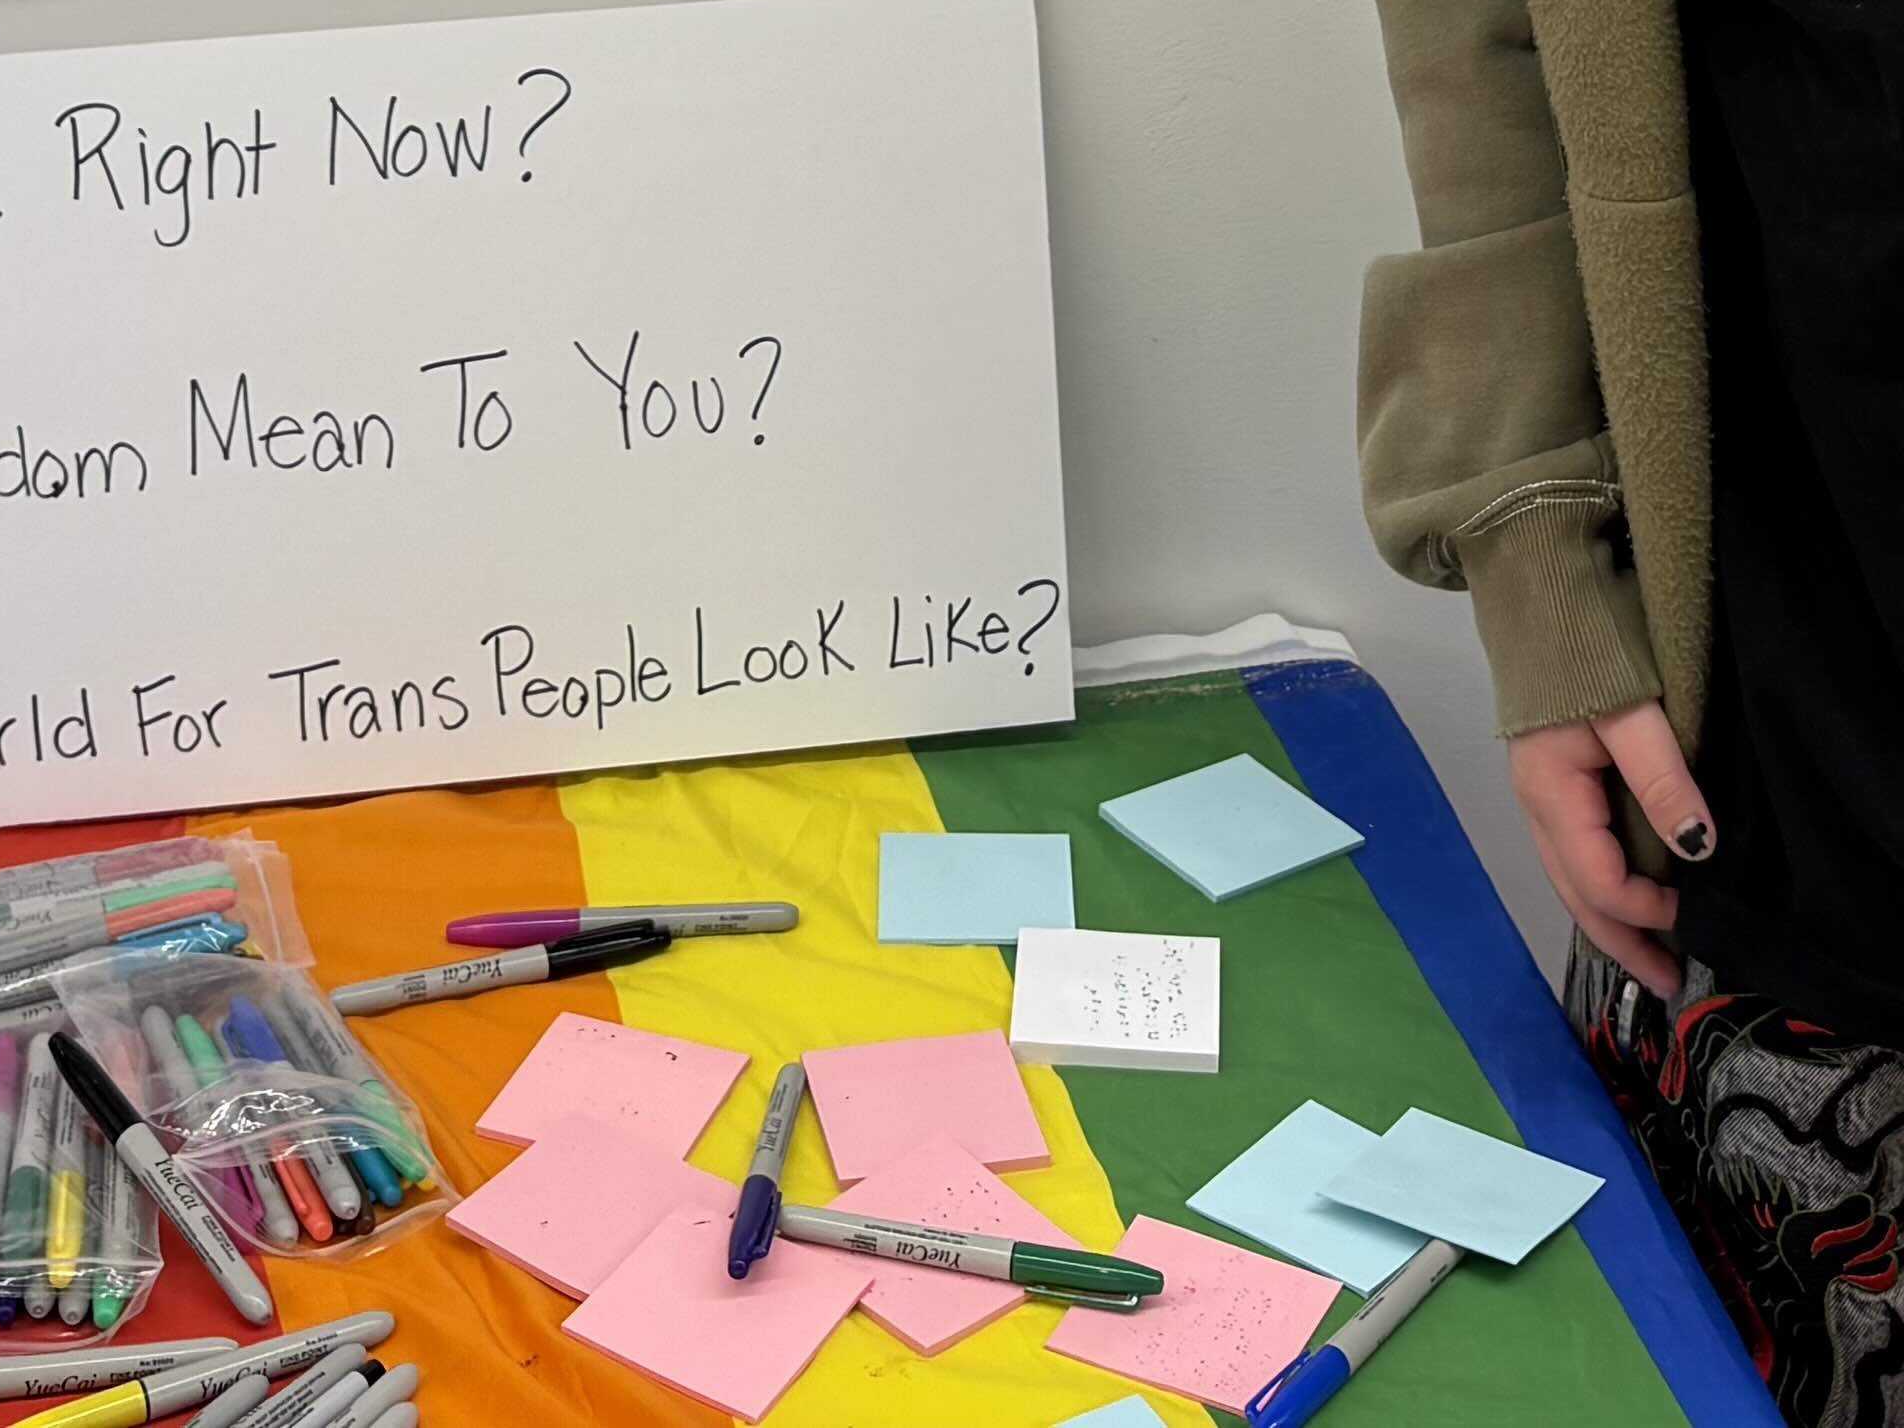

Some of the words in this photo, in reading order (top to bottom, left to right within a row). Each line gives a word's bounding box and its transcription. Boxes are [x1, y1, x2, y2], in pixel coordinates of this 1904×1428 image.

[54, 102, 277, 248] Right
[327, 65, 573, 188] Now?
[187, 371, 396, 477] Mean
[420, 348, 514, 453] To
[572, 328, 784, 450] You?
[131, 674, 229, 761] For
[266, 658, 471, 746] Trans
[479, 622, 674, 734] People
[694, 595, 857, 697] Look
[886, 576, 1063, 678] Like?
[442, 957, 503, 987] YueCai
[154, 1158, 203, 1211] YueCai
[896, 1240, 963, 1268] YueCai
[24, 1373, 99, 1397] YueCai
